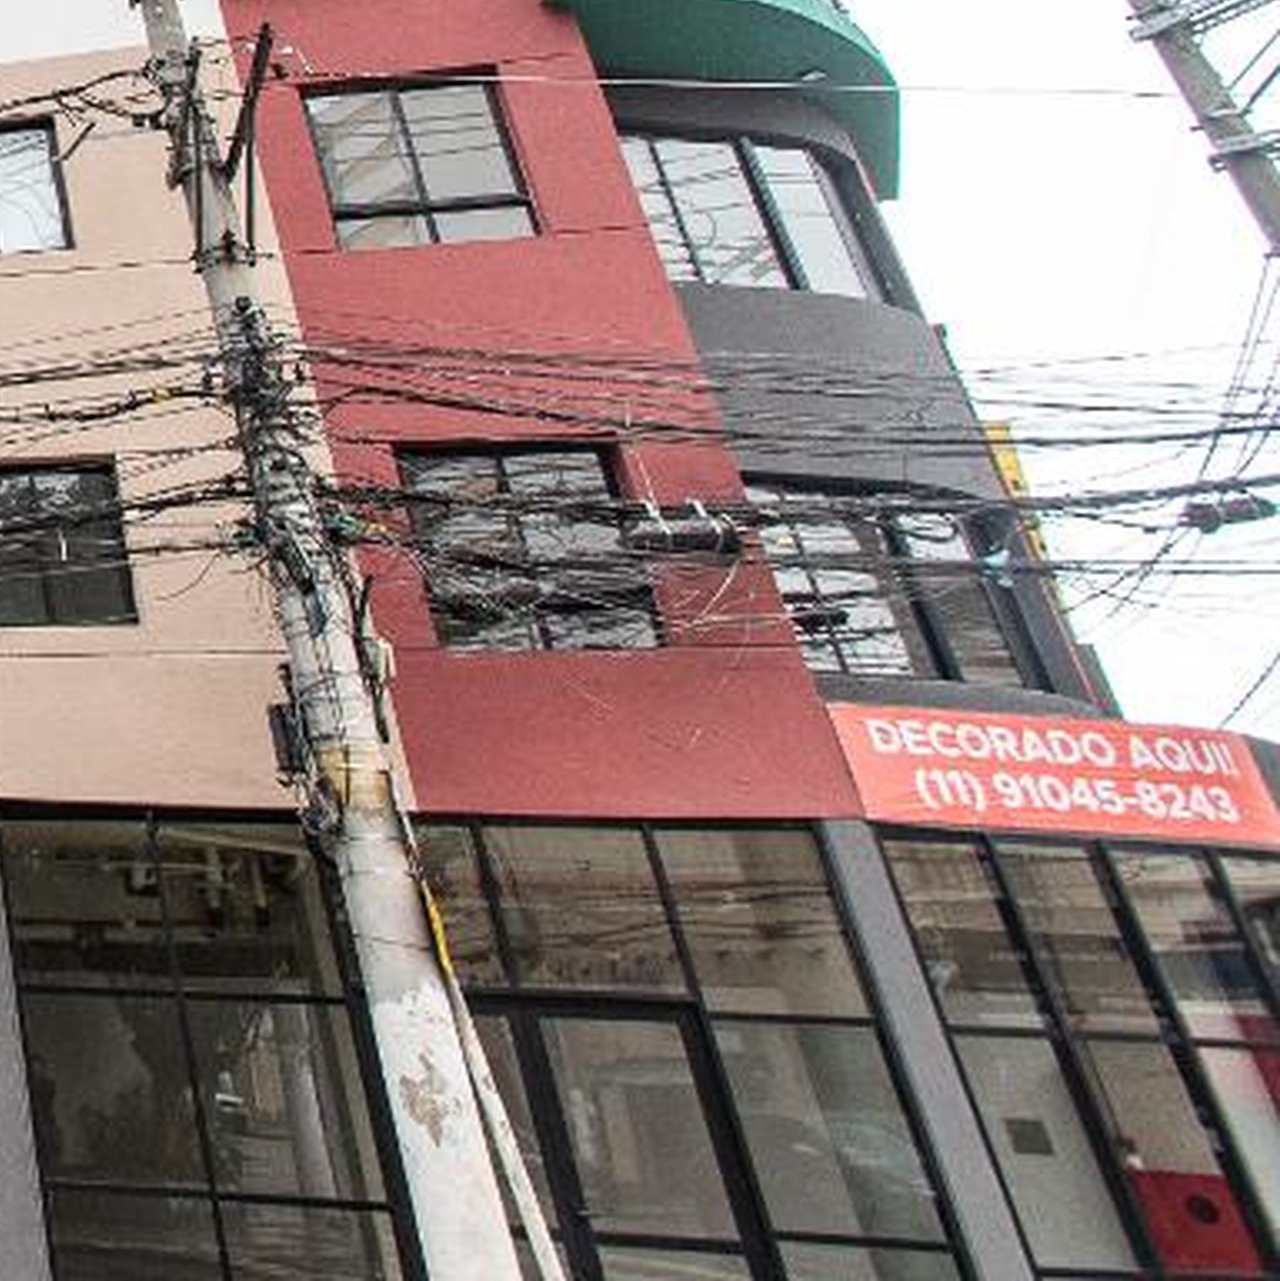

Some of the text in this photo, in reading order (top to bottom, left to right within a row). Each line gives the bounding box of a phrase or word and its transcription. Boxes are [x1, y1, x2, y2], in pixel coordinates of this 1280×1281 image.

[865, 718, 1117, 768] DECORADO
[914, 768, 1239, 824] (11) 91045-8243
